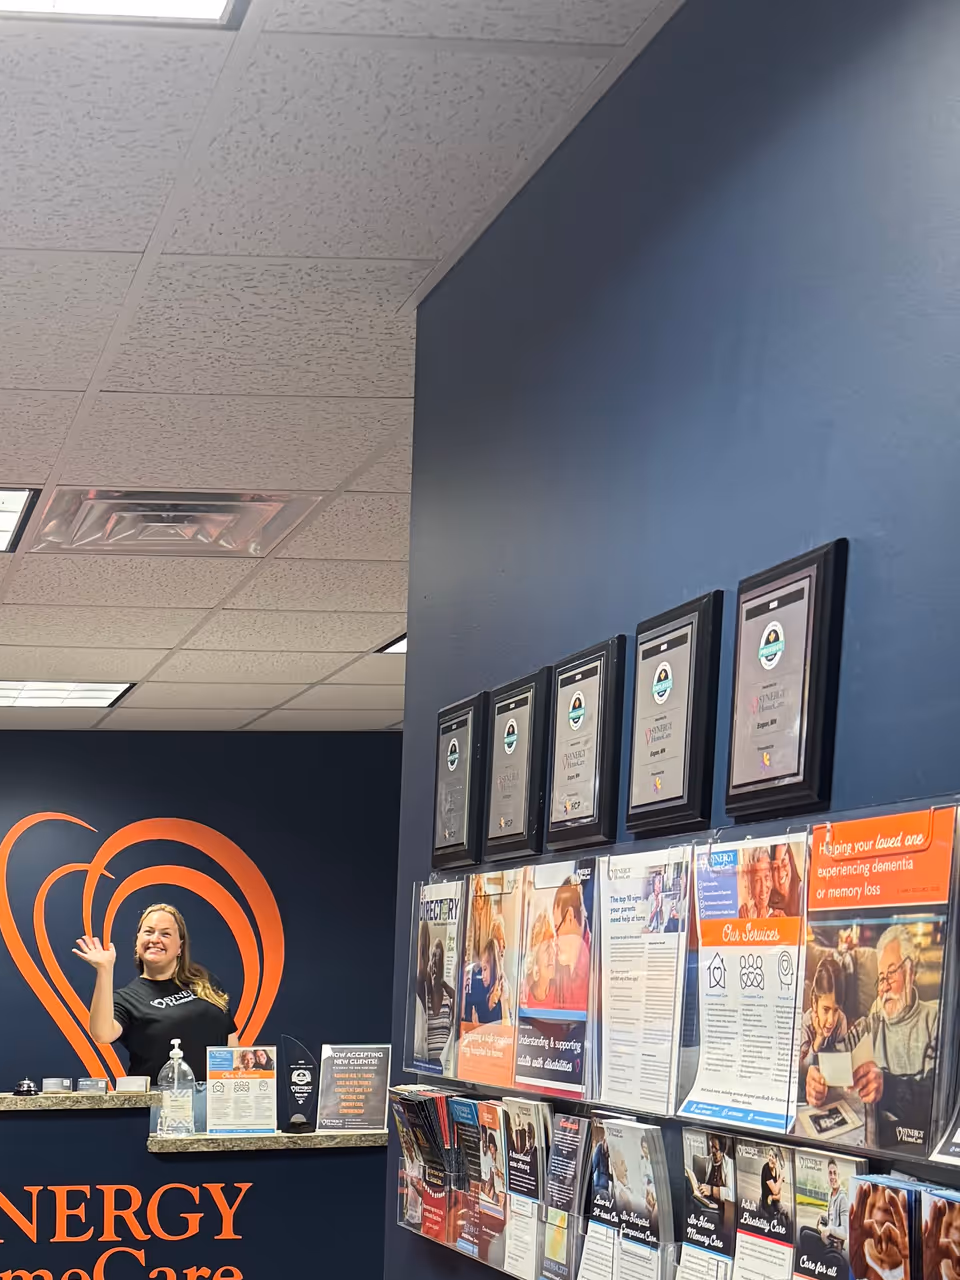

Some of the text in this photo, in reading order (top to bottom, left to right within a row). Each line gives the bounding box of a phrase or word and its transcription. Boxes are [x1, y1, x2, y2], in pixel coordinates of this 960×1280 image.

[854, 839, 874, 855] your
[875, 831, 903, 850] loved
[904, 832, 925, 846] one
[817, 856, 914, 880] experiencing dementia
[816, 888, 826, 899] or
[827, 885, 863, 900] memory
[864, 881, 881, 896] loss
[722, 922, 781, 942] Our Services
[519, 1033, 549, 1050] Understanding
[555, 1039, 582, 1054] supporting
[740, 1198, 757, 1212] Adult
[621, 1223, 645, 1240] Companion
[740, 1211, 787, 1235] Disability Care
[686, 1226, 724, 1248] Memory Care
[799, 1254, 838, 1277] Care for all
